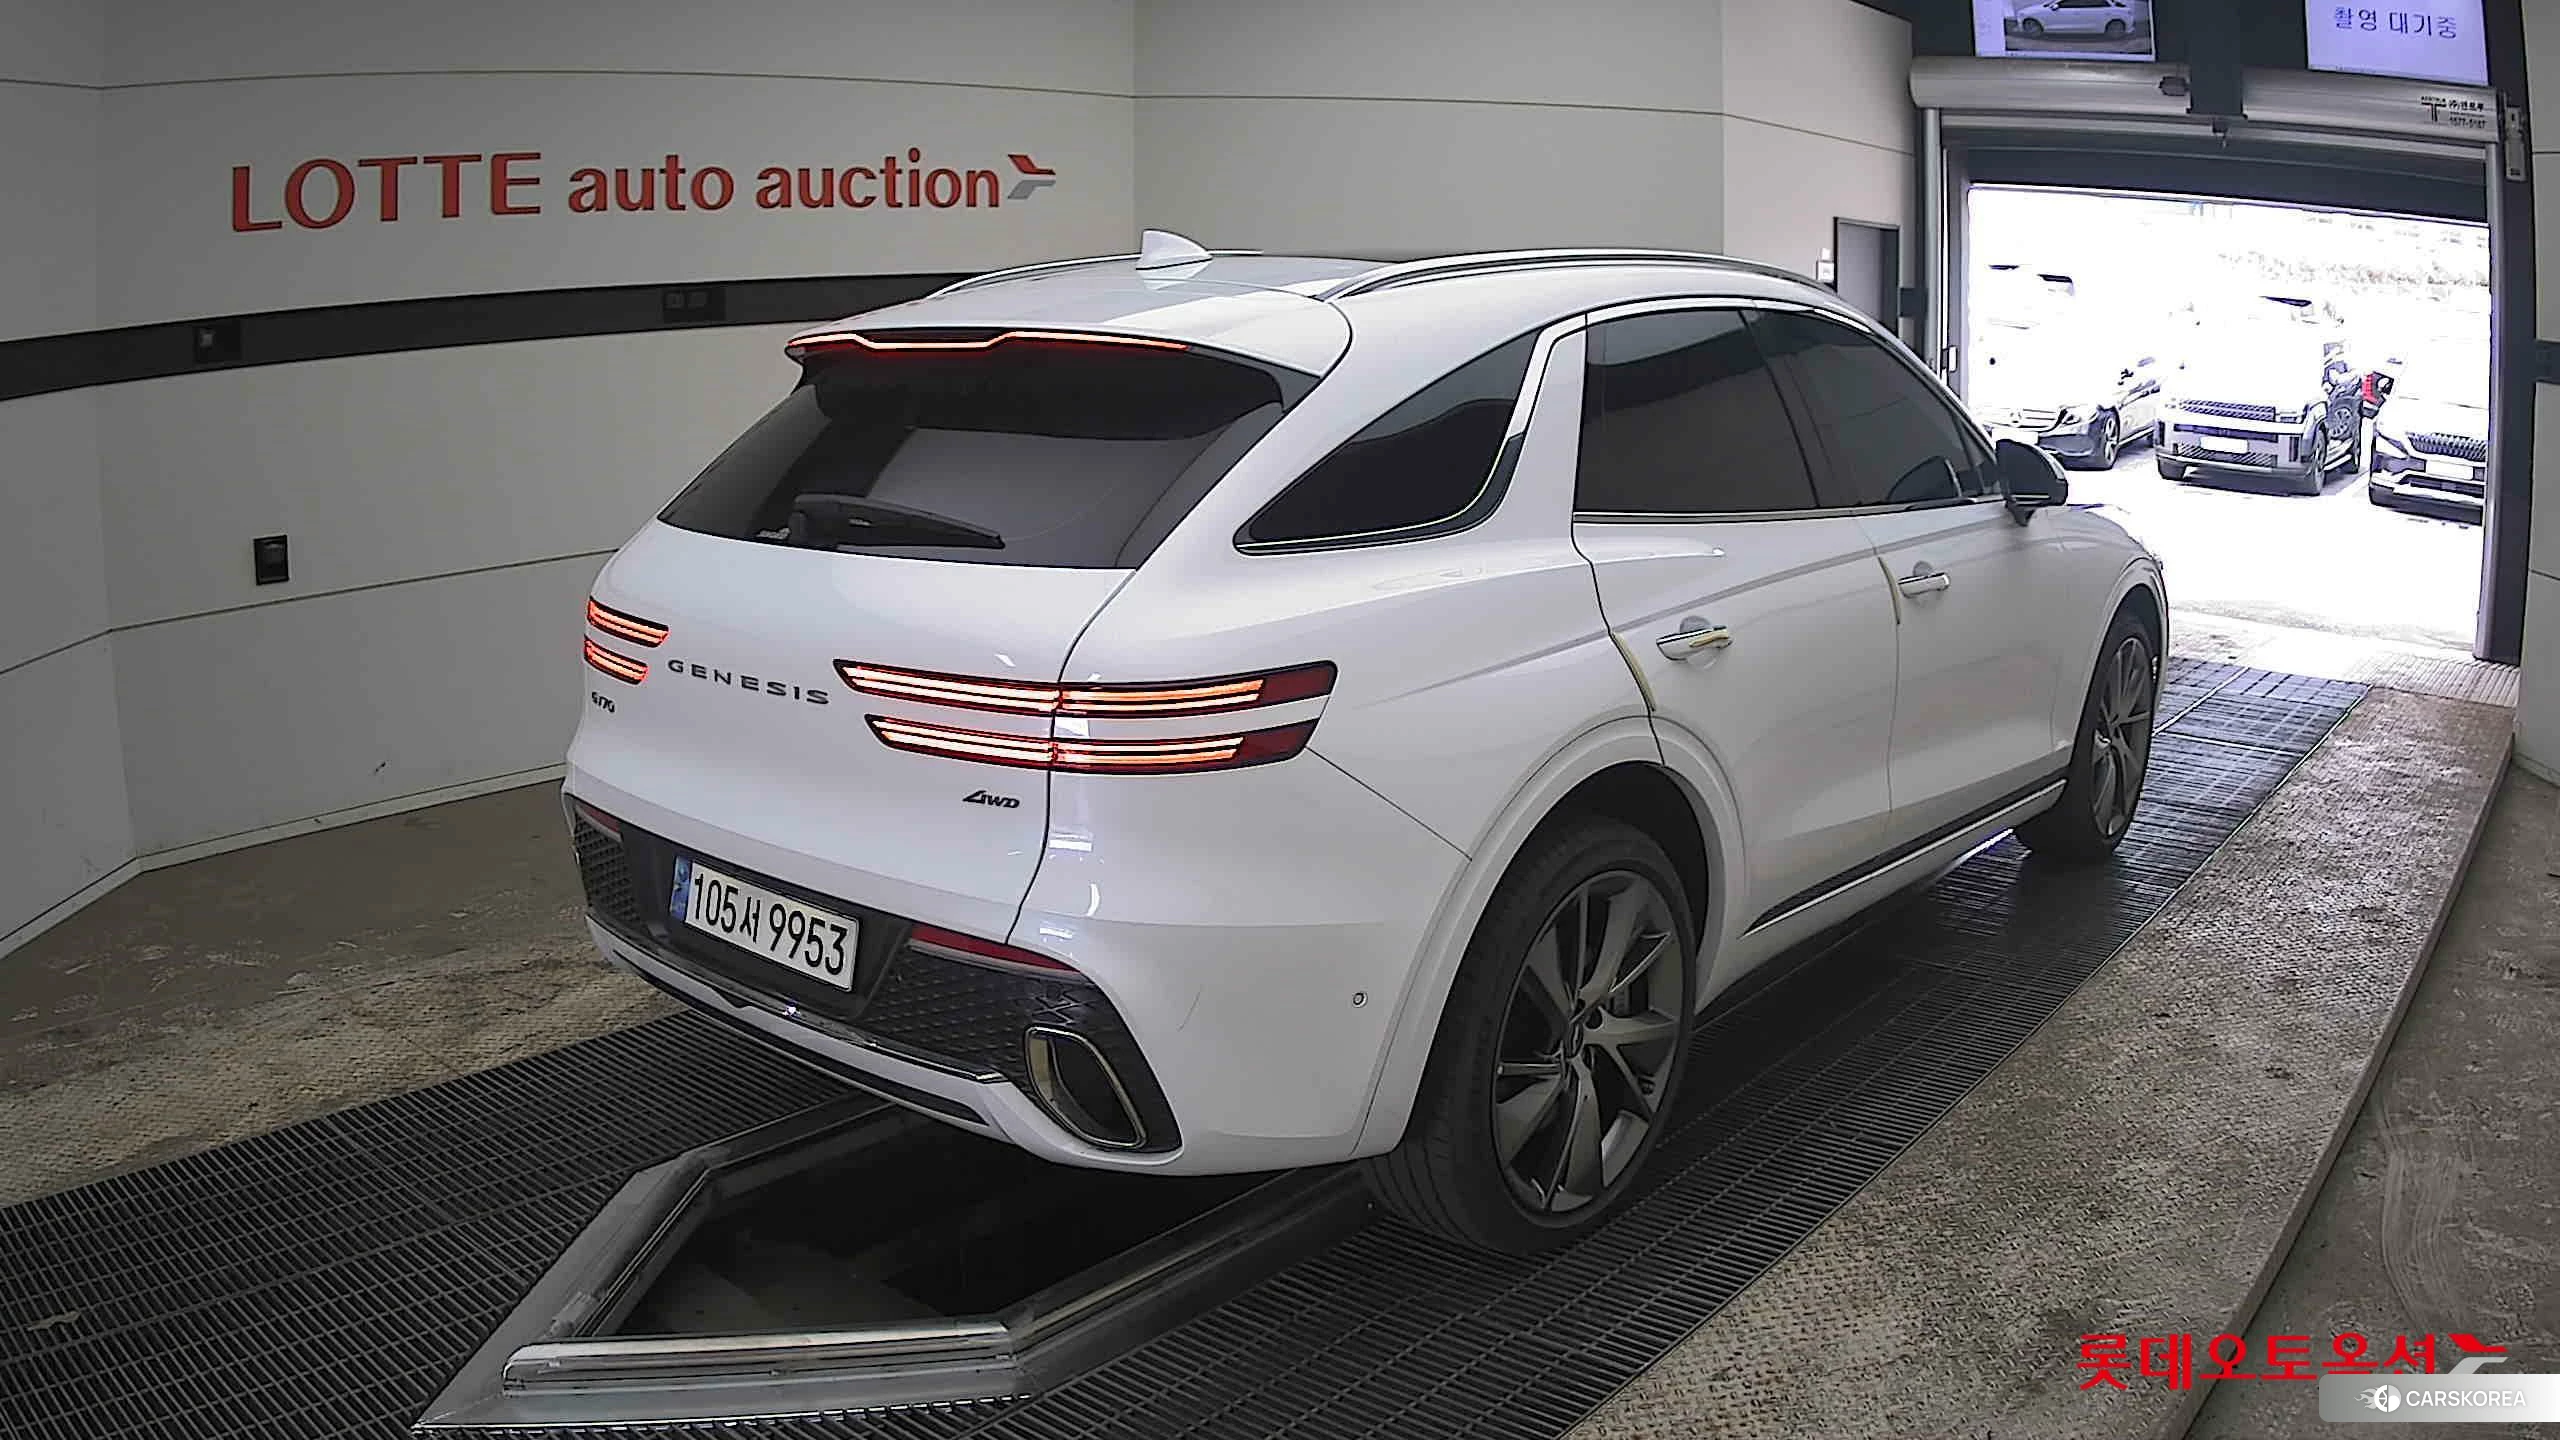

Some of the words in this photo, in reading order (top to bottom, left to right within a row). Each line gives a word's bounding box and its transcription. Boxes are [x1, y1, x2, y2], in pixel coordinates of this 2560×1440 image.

[2335, 7, 2377, 31] 촬영
[2389, 12, 2457, 39] 대기중
[232, 152, 541, 232] LOTTE
[568, 154, 734, 213] auto
[756, 147, 1000, 209] auction
[667, 659, 829, 705] GENESIS
[962, 789, 1020, 809] 4WD
